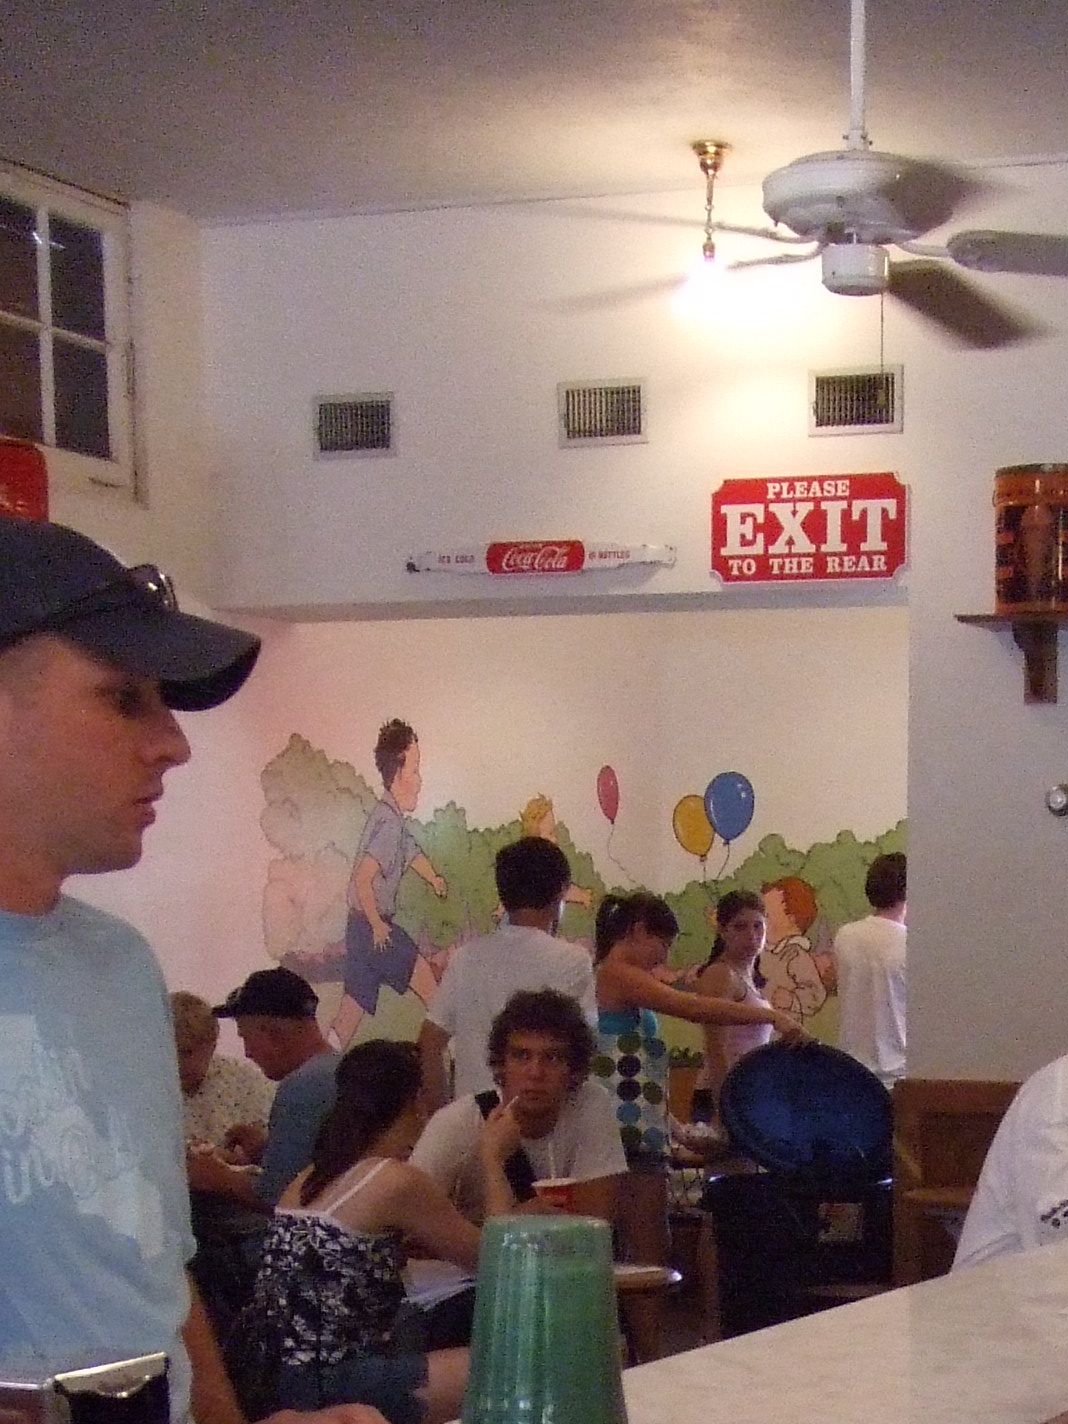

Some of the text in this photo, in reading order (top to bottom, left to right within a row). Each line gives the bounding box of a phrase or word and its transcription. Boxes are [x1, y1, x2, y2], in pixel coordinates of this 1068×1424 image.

[766, 480, 850, 499] PLEASE
[720, 499, 897, 556] EXIT
[728, 555, 887, 576] TO THE REAR
